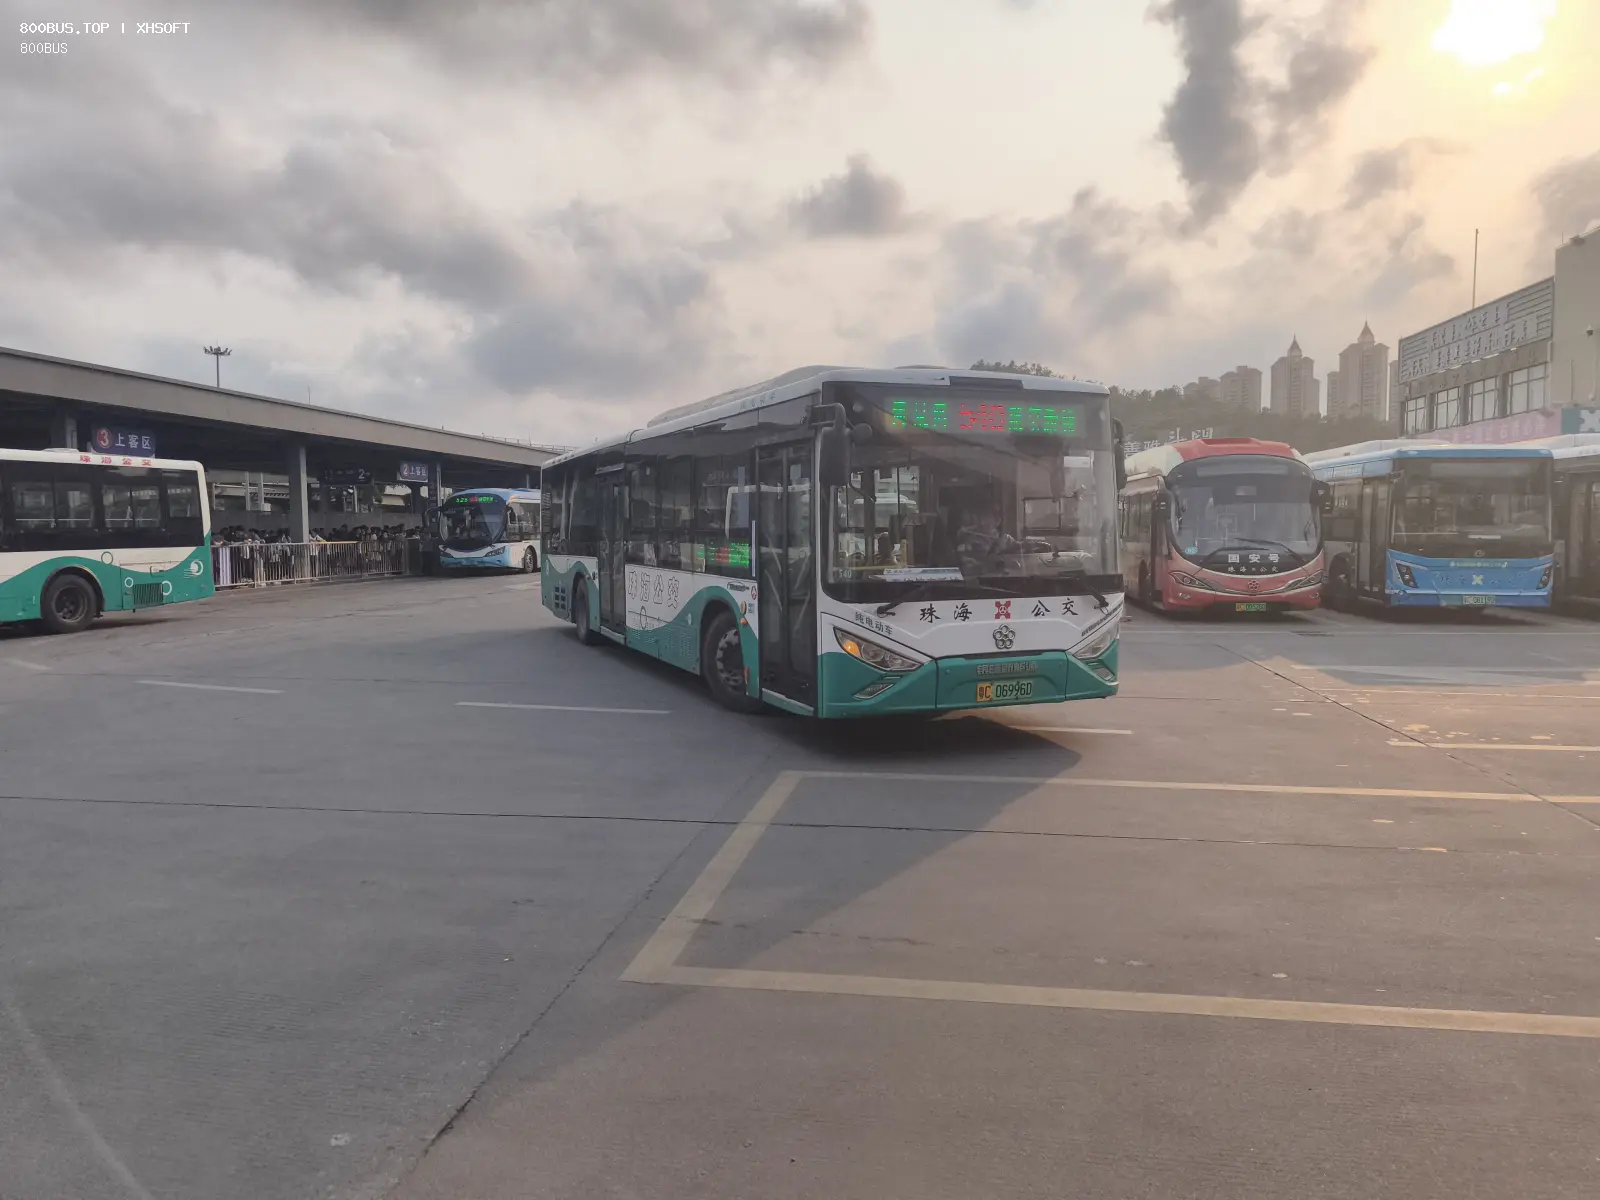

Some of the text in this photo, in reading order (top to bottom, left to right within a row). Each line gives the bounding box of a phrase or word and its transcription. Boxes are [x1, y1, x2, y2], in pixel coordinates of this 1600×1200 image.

[99, 429, 152, 450] 3 上客区
[1228, 553, 1280, 563] 国安号
[855, 611, 893, 636] 纯电动车
